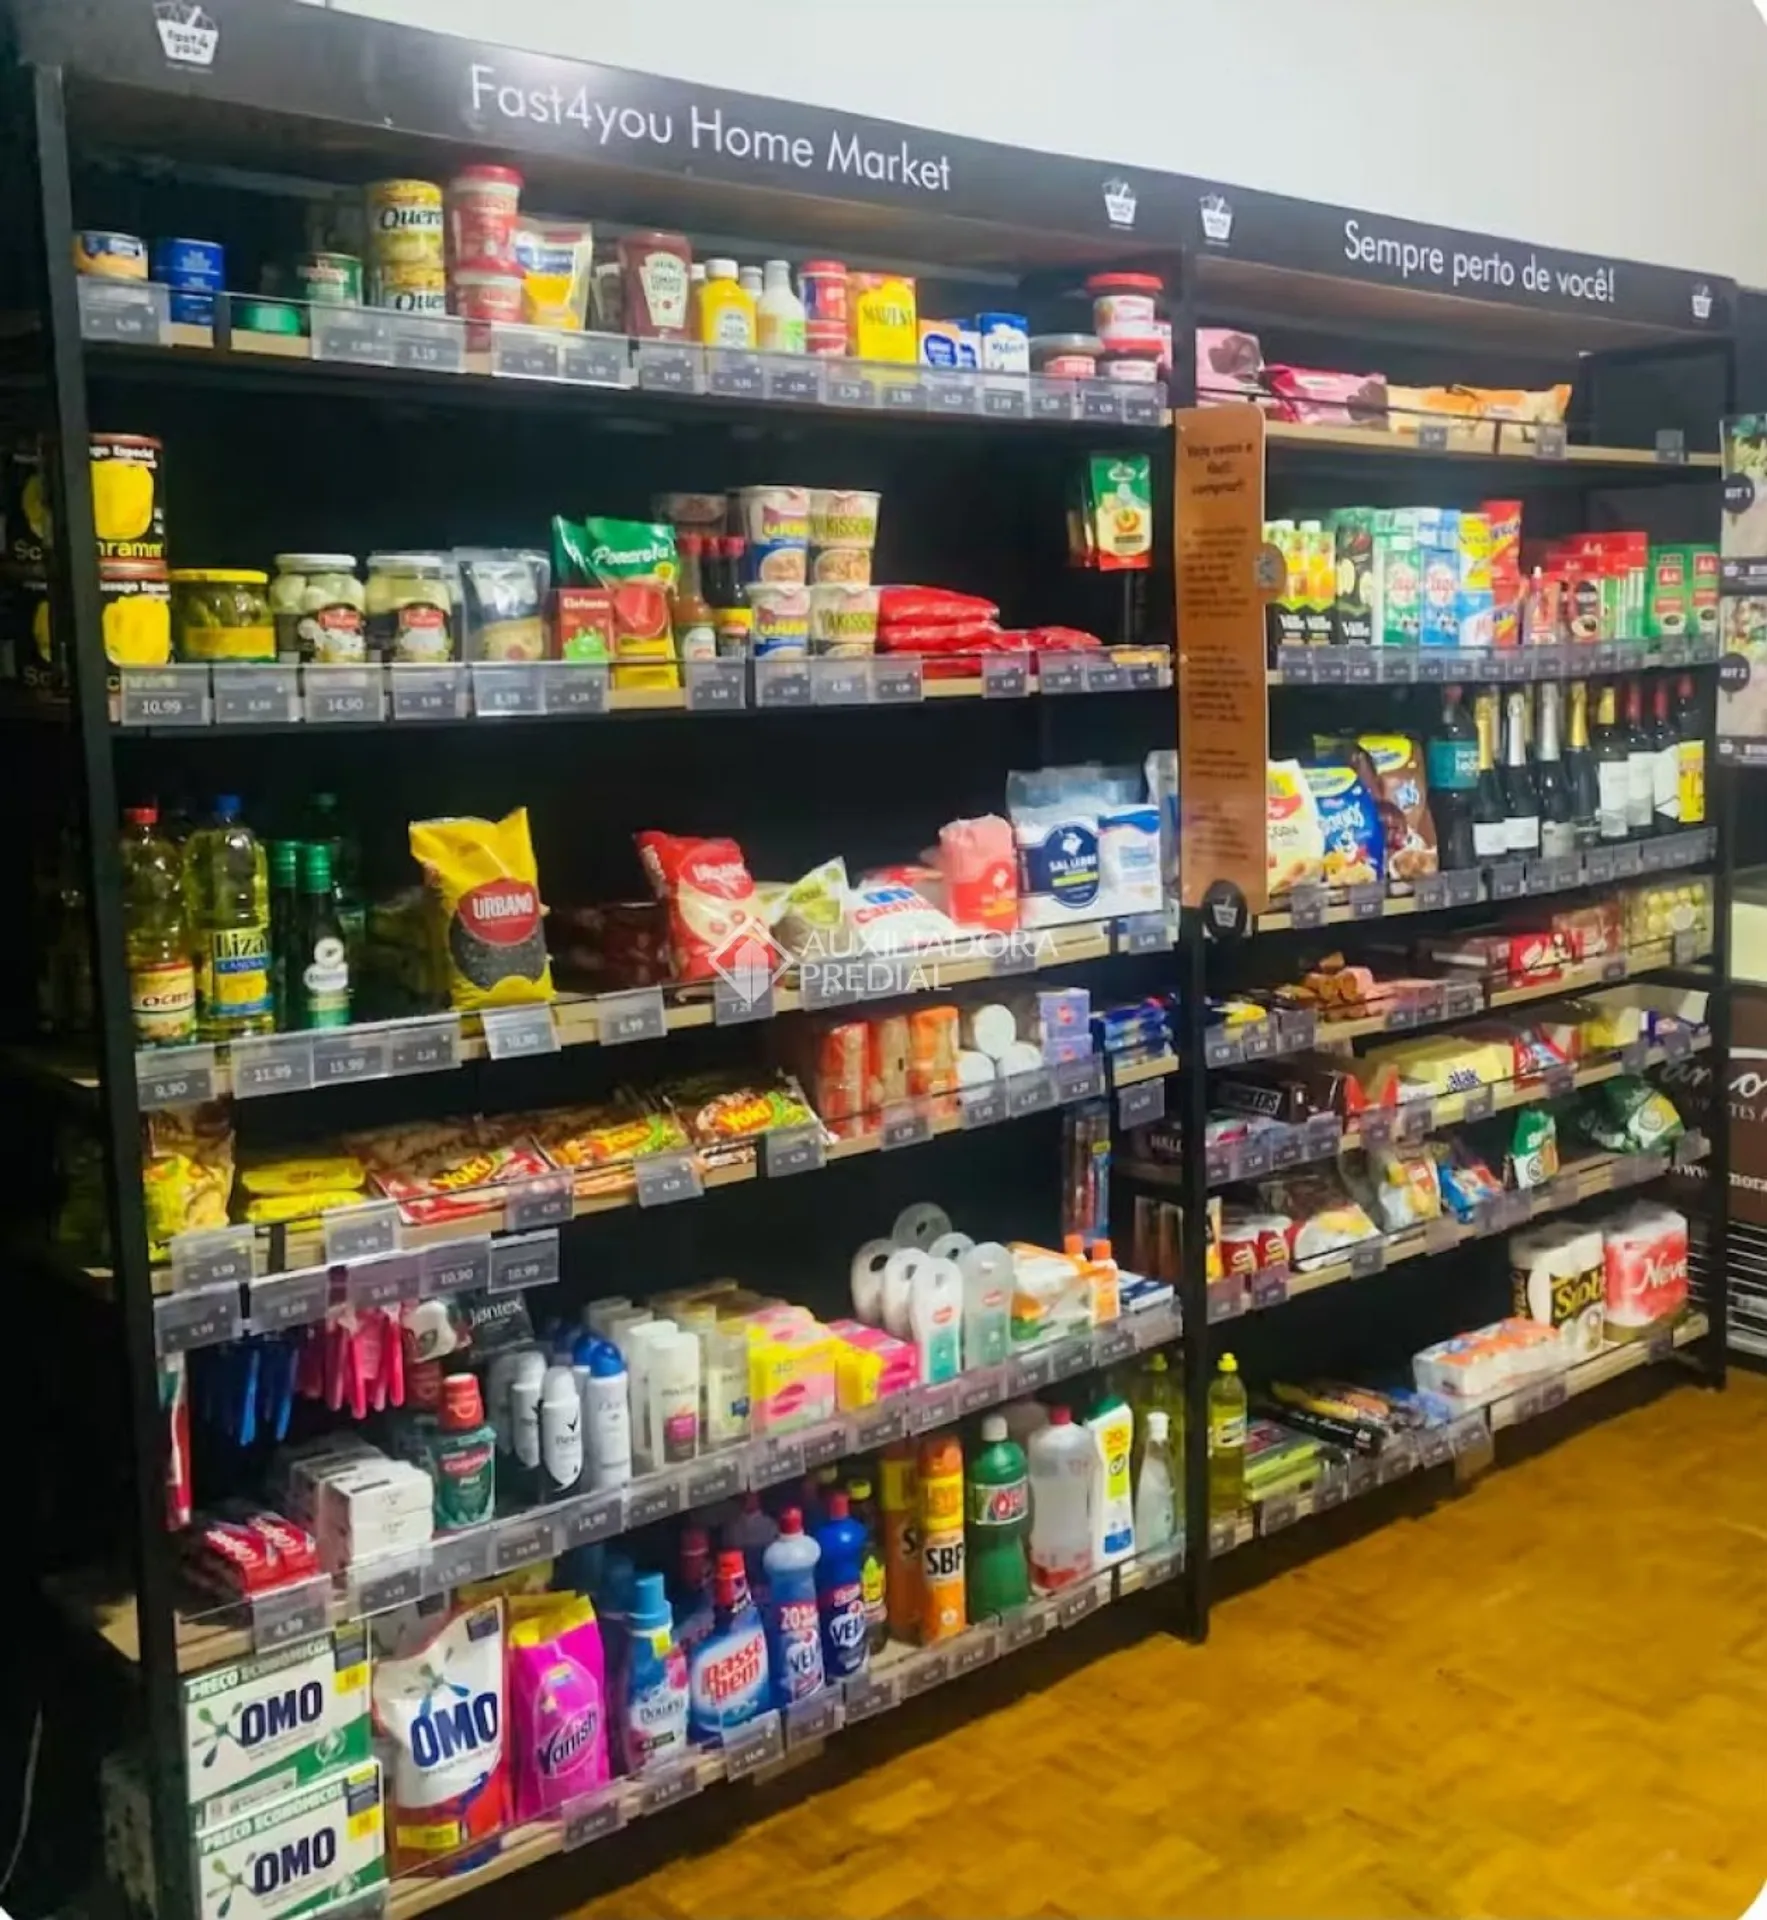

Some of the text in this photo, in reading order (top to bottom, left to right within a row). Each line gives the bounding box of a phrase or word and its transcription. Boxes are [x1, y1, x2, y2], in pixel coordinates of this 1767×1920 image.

[470, 63, 952, 193] Fast4you Home Market
[1344, 219, 1616, 304] Sempre perto de você!
[241, 1681, 323, 1748] OMO
[409, 1692, 498, 1768] OMO
[537, 1709, 598, 1776] Vanish
[254, 1826, 336, 1897] OMO
